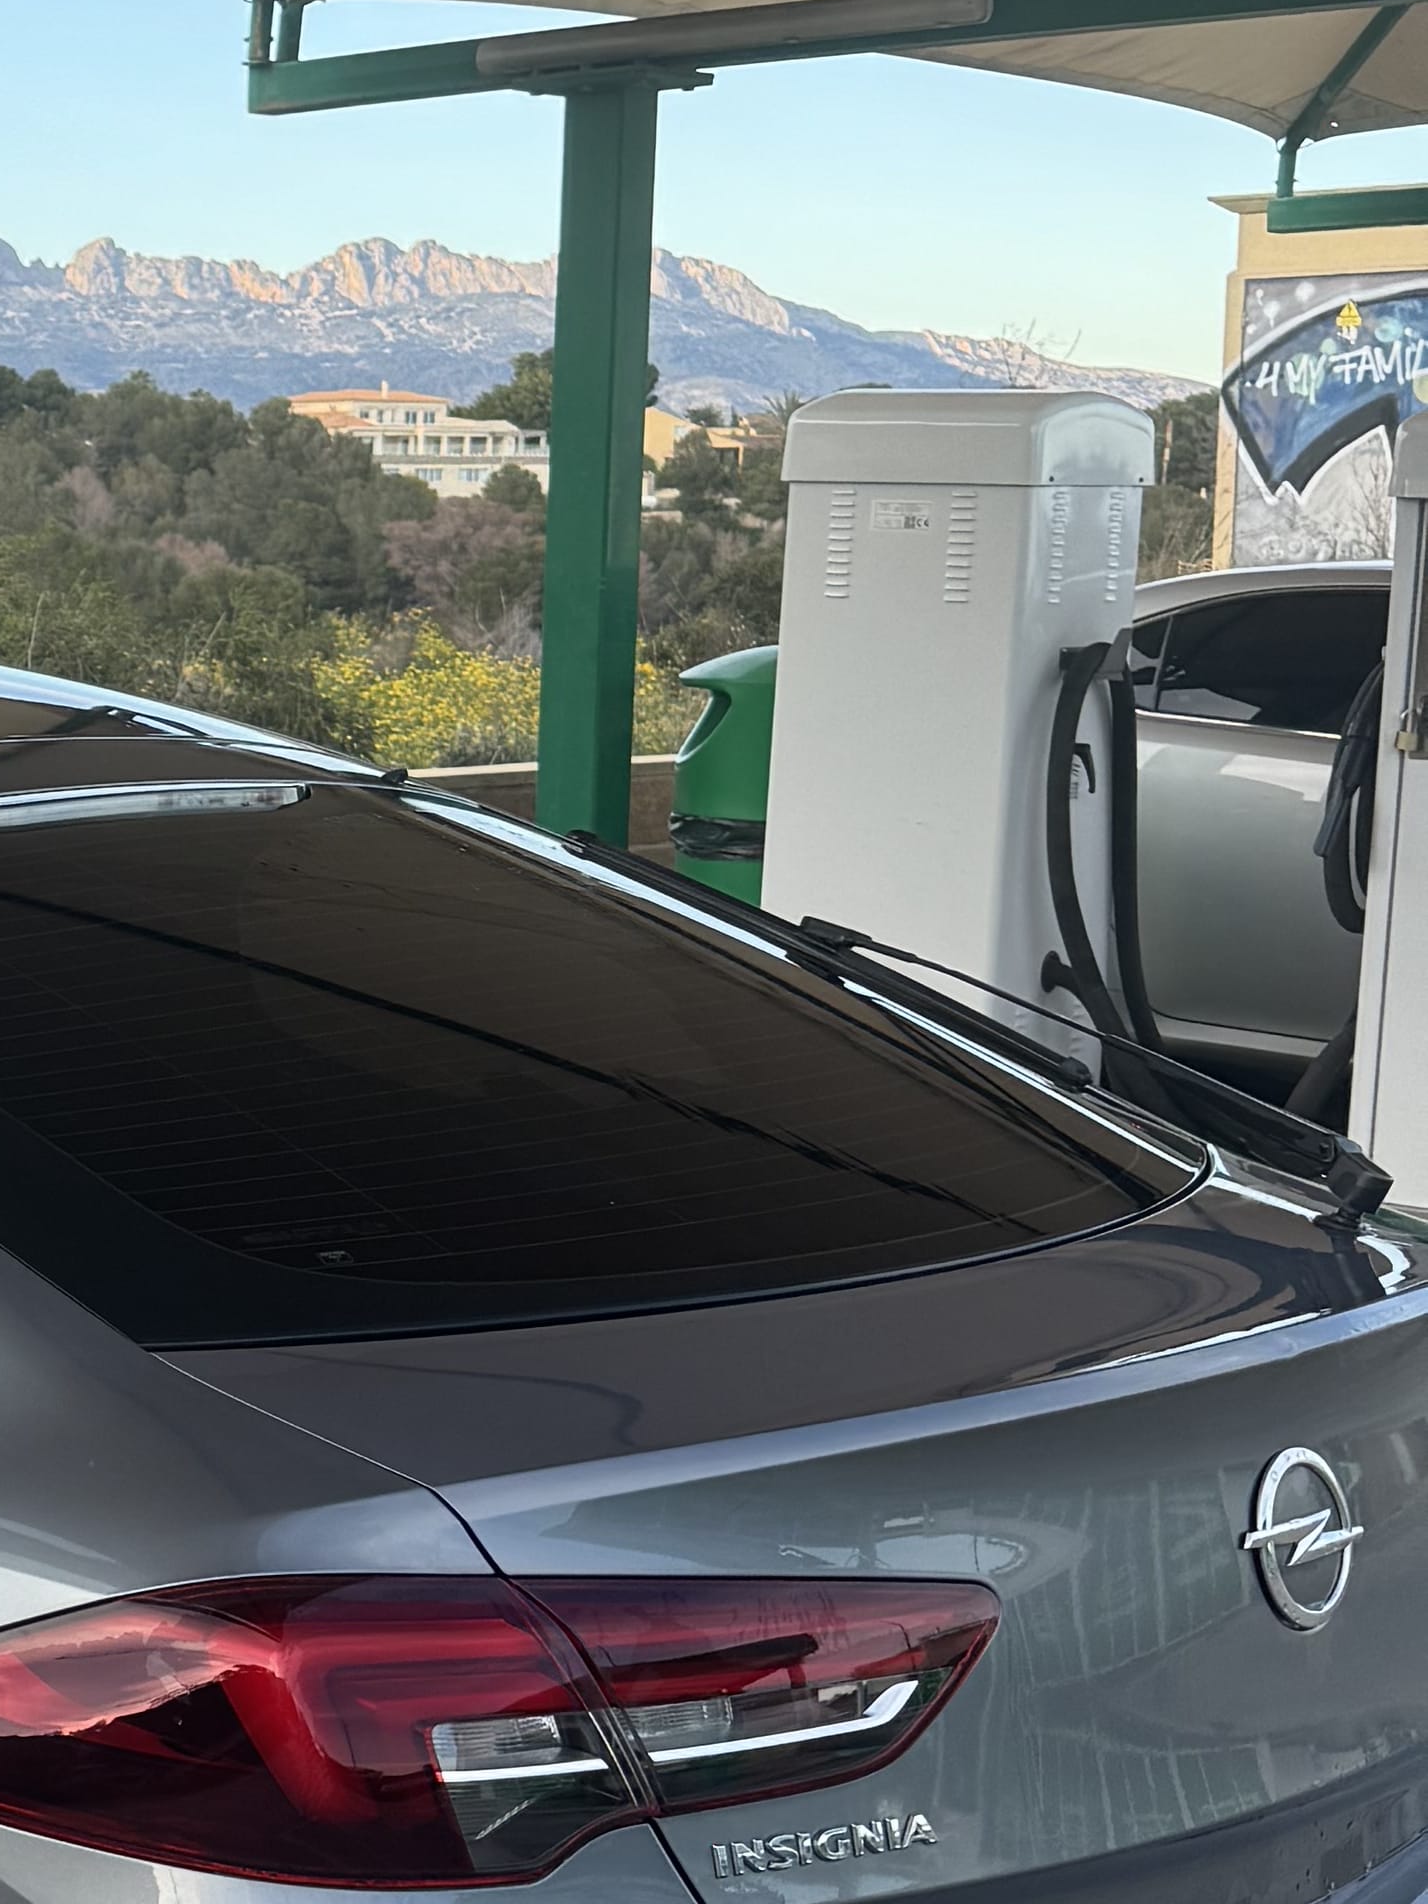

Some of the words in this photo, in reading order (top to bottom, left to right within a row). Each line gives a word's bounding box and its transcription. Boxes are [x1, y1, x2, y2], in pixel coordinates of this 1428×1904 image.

[1285, 353, 1327, 406] MY
[1328, 339, 1428, 386] FAMIL
[711, 1813, 939, 1879] INSIGNIA
